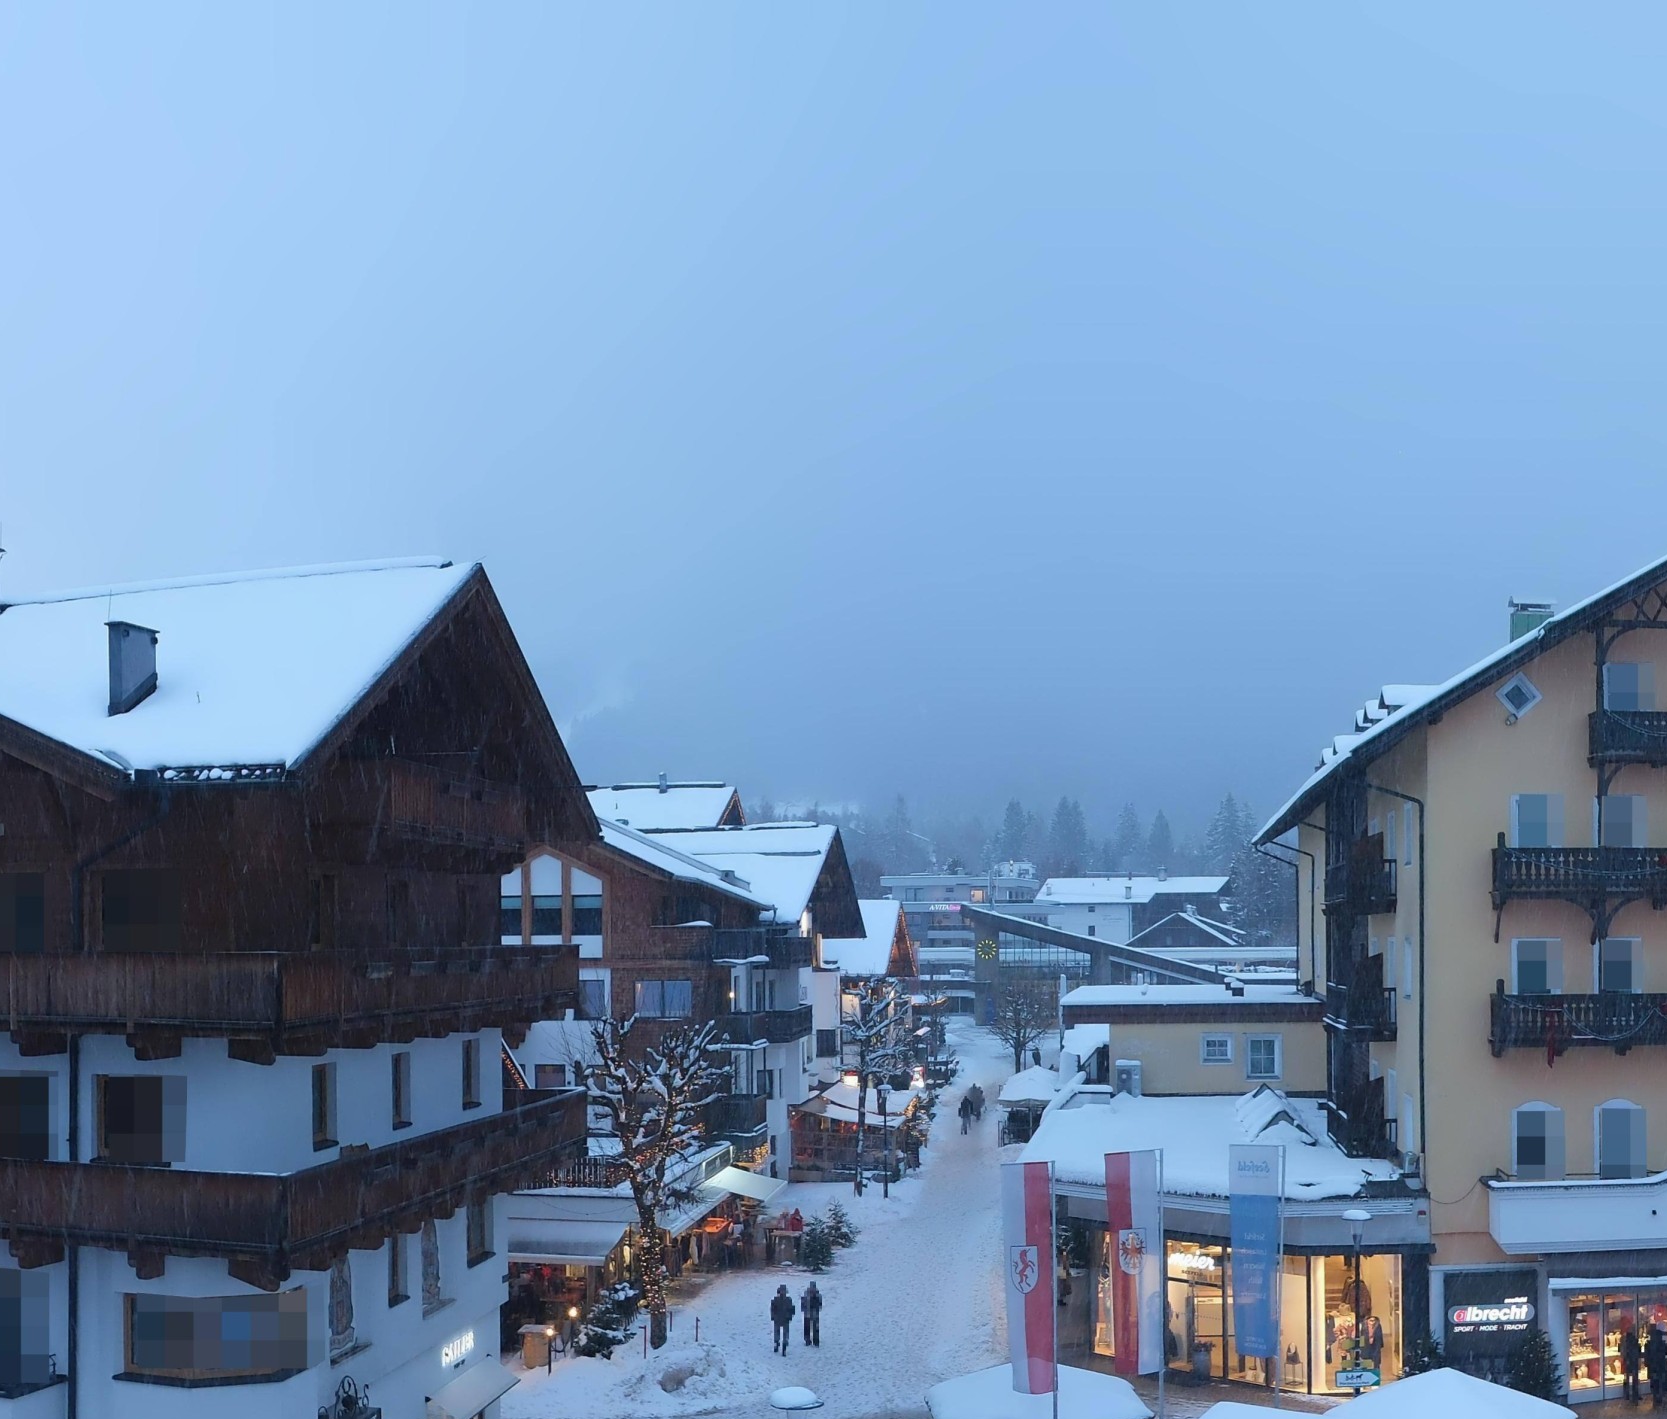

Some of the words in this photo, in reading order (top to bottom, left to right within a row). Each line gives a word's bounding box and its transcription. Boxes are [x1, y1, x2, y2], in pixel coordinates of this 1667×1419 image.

[1454, 1305, 1528, 1323] albrecht
[1454, 1325, 1475, 1333] SPORT
[1504, 1323, 1528, 1331] TRACHT
